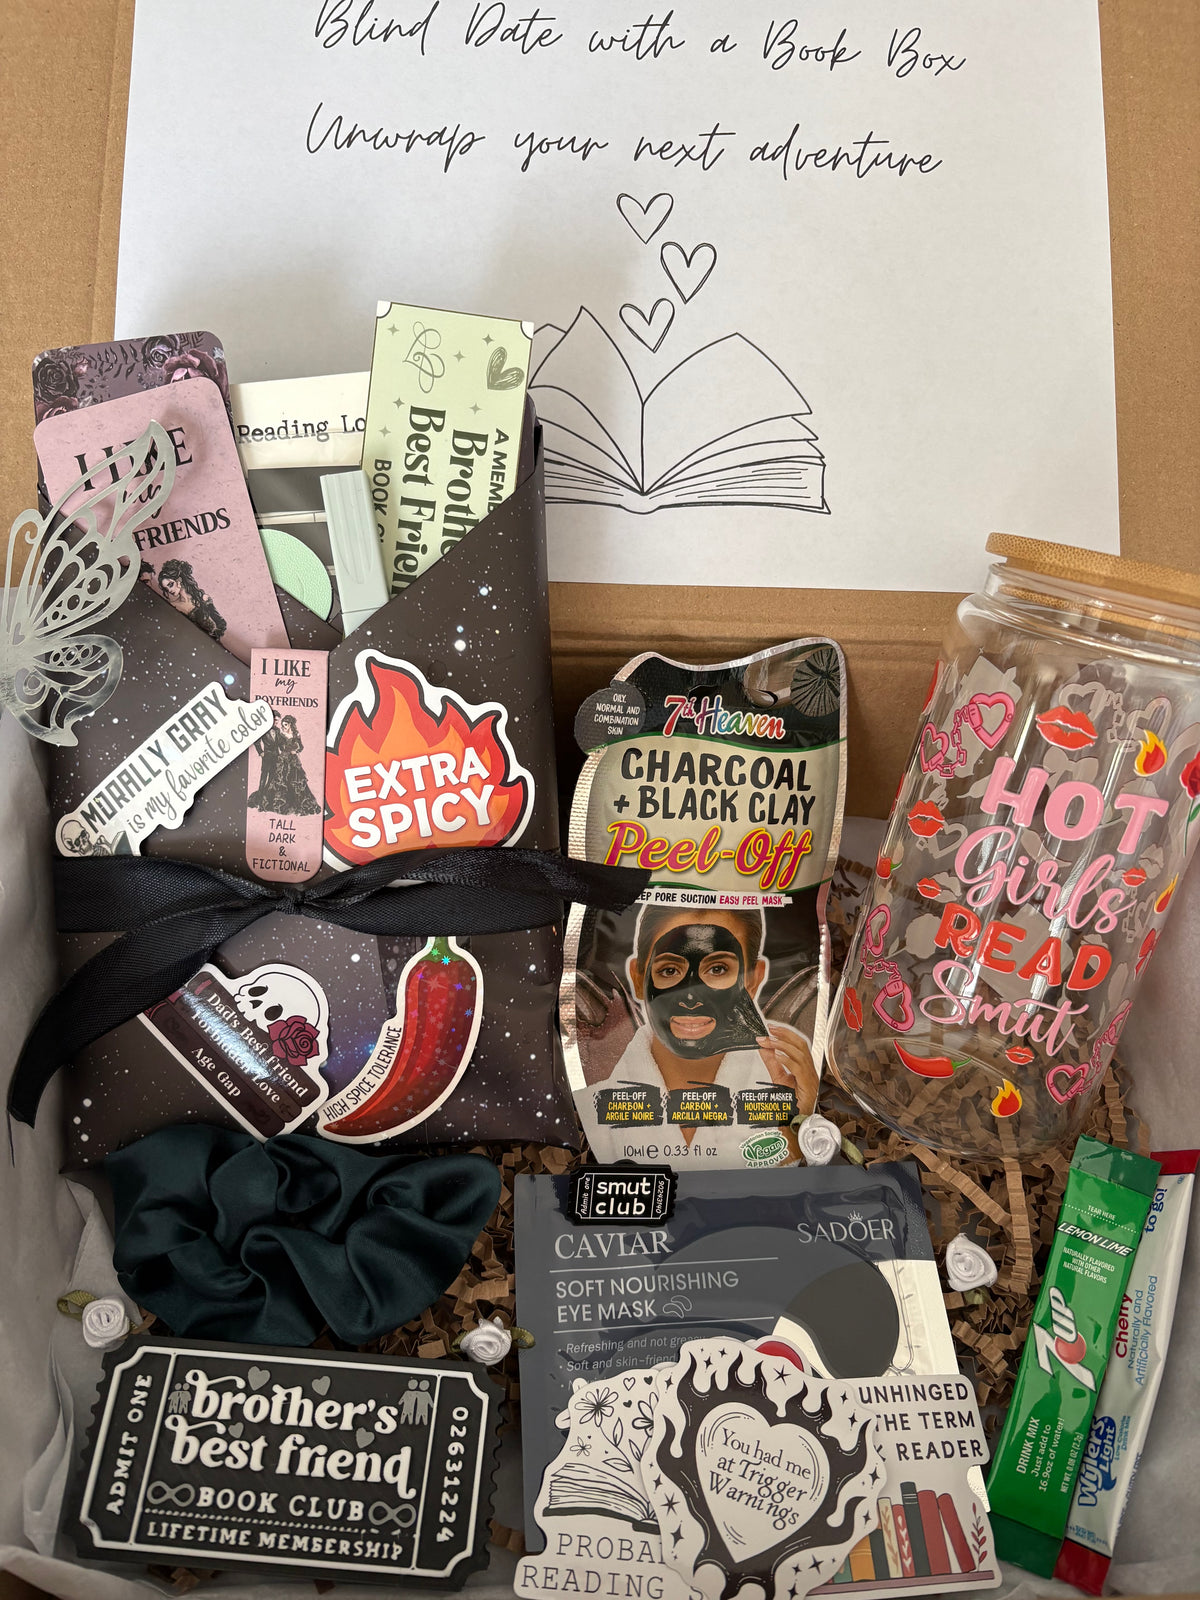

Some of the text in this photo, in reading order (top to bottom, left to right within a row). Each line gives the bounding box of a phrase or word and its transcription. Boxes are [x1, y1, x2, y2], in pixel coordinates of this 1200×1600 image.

[314, 0, 966, 78] Blind Date with a Book Box
[306, 102, 943, 181] Unwrap your next adventure
[237, 419, 330, 443] Reading
[402, 405, 446, 487] Best
[494, 428, 510, 445] A
[371, 458, 392, 516] BOOK
[261, 658, 311, 677] I LIKE
[275, 678, 298, 694] my
[593, 714, 640, 726] COMBINATION
[596, 703, 641, 716] NORMAL AND
[663, 694, 786, 739] 7th Heaven
[607, 726, 624, 736] SKIN
[80, 689, 228, 834] MORALLY GRAY
[127, 705, 268, 834] is my favorite color
[344, 747, 490, 803] EXTRA
[621, 747, 812, 792] CHARCOAL
[349, 784, 495, 848] SPICY
[614, 785, 816, 826] + BLACK CLAY
[980, 756, 1169, 855] HOT
[268, 832, 296, 844] DARK
[269, 818, 296, 831] TALL
[252, 858, 311, 872] FICTIONAL
[279, 846, 287, 857] &
[603, 820, 813, 890] Peel-Off
[955, 825, 1137, 933] Girls
[655, 892, 678, 902] PORE
[680, 893, 717, 904] SUCTION
[719, 895, 740, 906] EASY
[742, 896, 759, 906] PEEL
[761, 895, 783, 905] MASK
[933, 902, 1112, 991] READ
[919, 960, 1089, 1056] Smut
[207, 993, 309, 1098] Dad's Best Friend
[191, 1047, 241, 1097] Age Gap
[323, 1025, 402, 1121] HIGH SPICE TOLERANCE
[251, 1074, 280, 1103] Love
[612, 1091, 647, 1101] PEEL-OFF
[682, 1091, 717, 1101] PEEL-OFF
[741, 1092, 793, 1102] PEEL-OFF MASKER
[605, 1111, 655, 1121] ARGILE NOIRE
[607, 1101, 644, 1111] CHARBON
[671, 1111, 728, 1121] ARCILLA NEGRA
[744, 1102, 791, 1111] HOUTSKOOL EN
[663, 1145, 689, 1157] 0.33
[693, 1145, 701, 1156] fl
[705, 1148, 718, 1156] oz
[746, 1140, 784, 1160] Vegan
[747, 1150, 788, 1167] APPROVED
[596, 1177, 651, 1195] smut
[580, 1192, 589, 1215] Admit
[595, 1197, 646, 1215] club
[1088, 1205, 1117, 1221] TEAR HERE
[1144, 1214, 1158, 1233] to
[1151, 1188, 1168, 1213] go!
[554, 1230, 673, 1260] CAVIAR
[797, 1218, 896, 1244] SADOER
[1057, 1222, 1133, 1256] LEMON LIME
[1063, 1246, 1115, 1272] NATURALLY FLAVORED
[1063, 1261, 1107, 1284] NATURAL FLAVORS
[1072, 1257, 1101, 1274] WITH OTHER
[556, 1270, 739, 1299] SOFT NOURISHING
[557, 1299, 657, 1323] EYE MASK
[1115, 1292, 1133, 1359] Cherry
[1127, 1289, 1144, 1369] Naturally and
[1135, 1275, 1158, 1386] Artificially Flavored
[566, 1339, 624, 1354] Refreshing
[626, 1337, 647, 1349] and
[650, 1336, 668, 1347] not
[566, 1358, 589, 1372] Soft
[592, 1357, 612, 1369] and
[185, 1368, 399, 1435] brother's
[859, 1383, 968, 1404] UNHINGED
[918, 1410, 975, 1429] TERM
[106, 1374, 153, 1515] ADMIT ONE
[164, 1414, 416, 1500] best friend
[722, 1427, 811, 1480] You had me
[896, 1439, 983, 1461] READER
[1016, 1416, 1040, 1474] DRINK MIX
[1031, 1424, 1051, 1477] Just add to
[1038, 1417, 1065, 1492] 16.9oz of water!
[1099, 1425, 1115, 1473] Light
[436, 1405, 470, 1543] 02631224
[717, 1456, 808, 1503] at Trigger
[196, 1486, 365, 1522] BOOK CLUB
[709, 1470, 799, 1530] Warnings
[146, 1521, 404, 1561] LIFETIME MEMBERSHIP
[521, 1565, 664, 1600] READING
